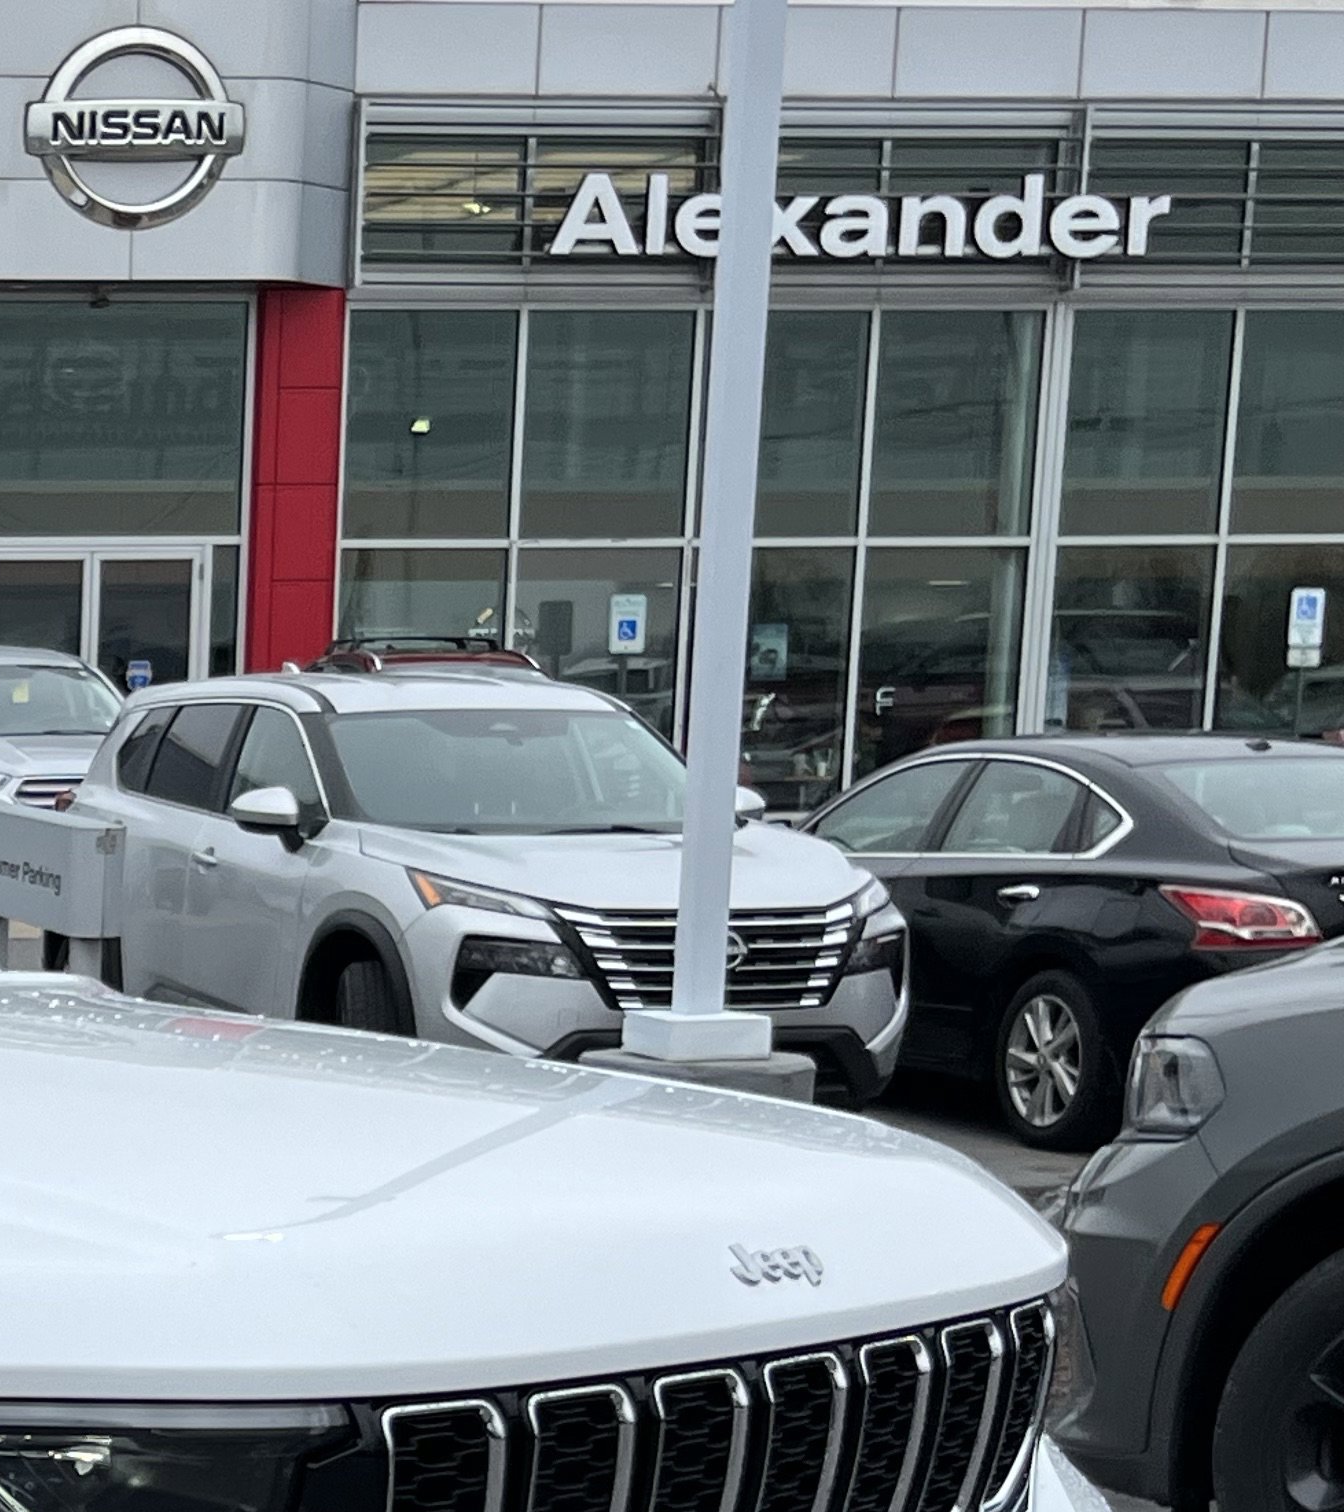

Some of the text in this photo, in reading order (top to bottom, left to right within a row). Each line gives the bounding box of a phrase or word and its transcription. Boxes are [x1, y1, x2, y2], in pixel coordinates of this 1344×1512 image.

[50, 108, 227, 145] NISSAN
[549, 171, 1173, 259] Alexander
[21, 861, 62, 897] Parking
[727, 1242, 824, 1288] Jeep
